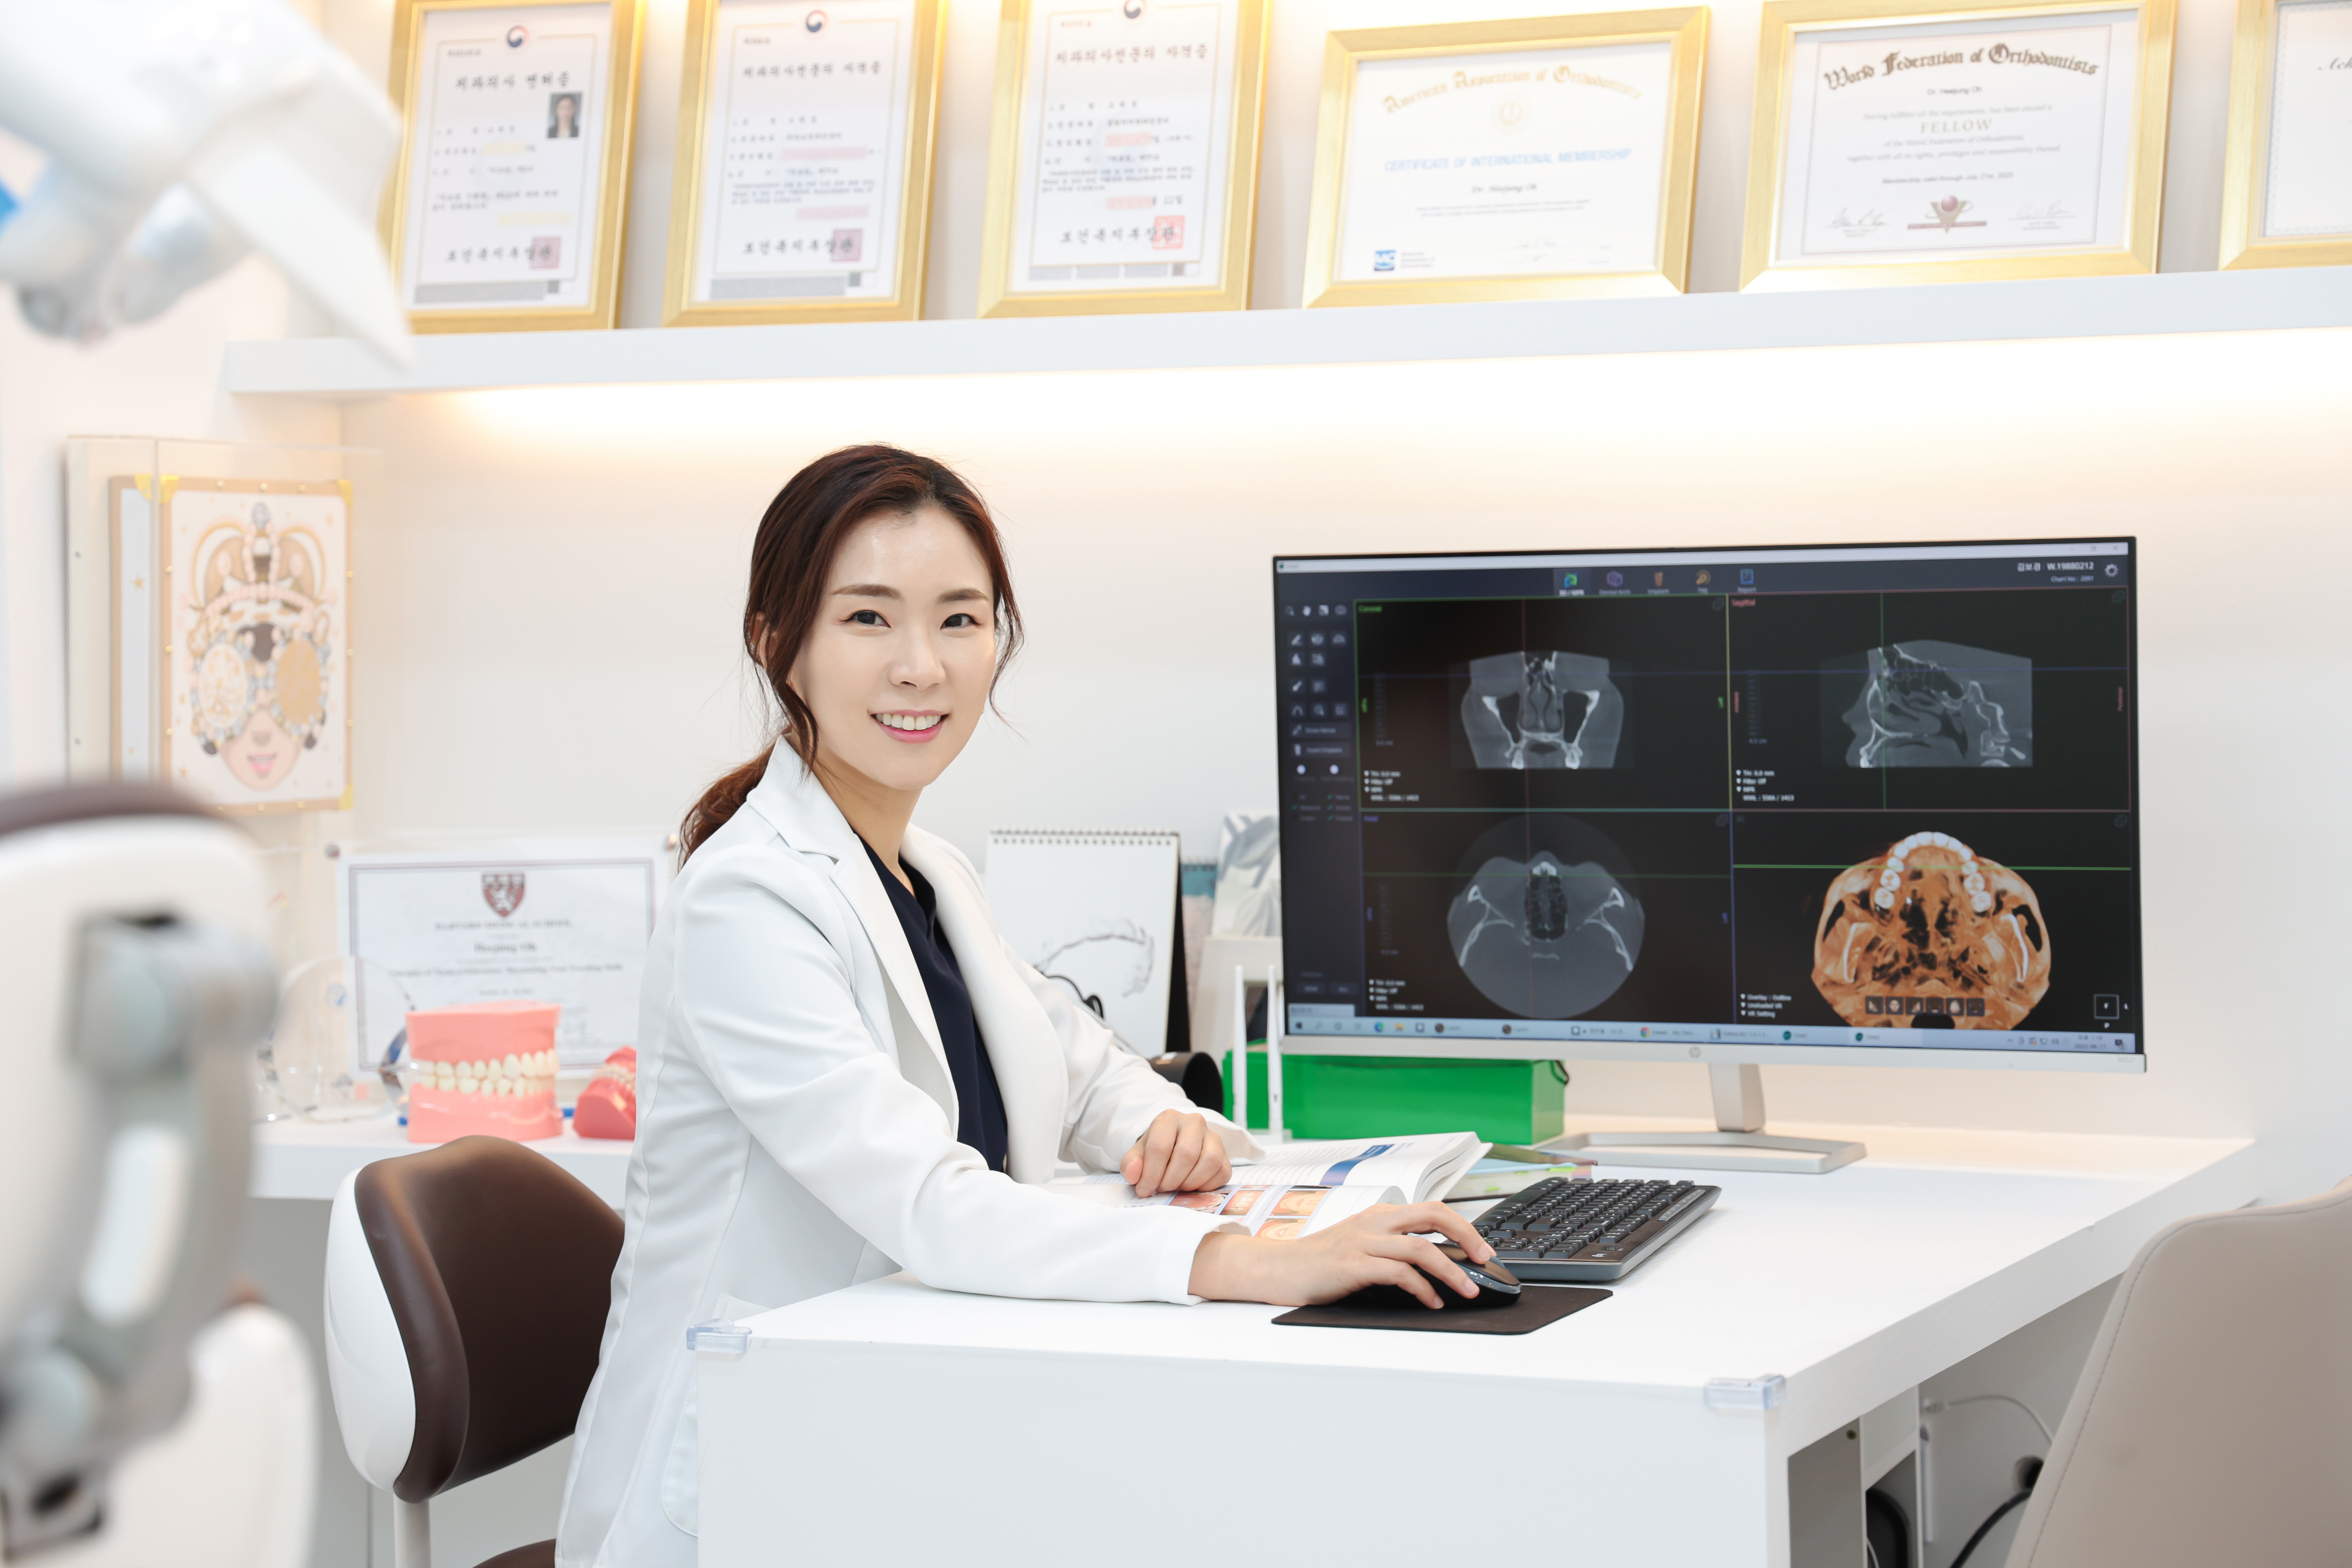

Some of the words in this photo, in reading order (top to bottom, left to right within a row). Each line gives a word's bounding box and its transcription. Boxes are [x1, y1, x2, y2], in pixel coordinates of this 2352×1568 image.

[1824, 64, 1875, 90] World
[1882, 50, 1964, 76] Federation
[1970, 48, 1984, 63] of
[1988, 42, 2100, 76] Orthodontists
[1383, 83, 1448, 114] American
[1453, 70, 1531, 89] Association
[1553, 64, 1643, 99] Orthodontists
[1920, 118, 1994, 134] FELLOW
[1384, 157, 1449, 172] CERTIFICATE
[1453, 157, 1467, 168] OF
[1470, 153, 1553, 167] INTERNATIONAL
[1558, 147, 1632, 162] MEMBERSHIP
